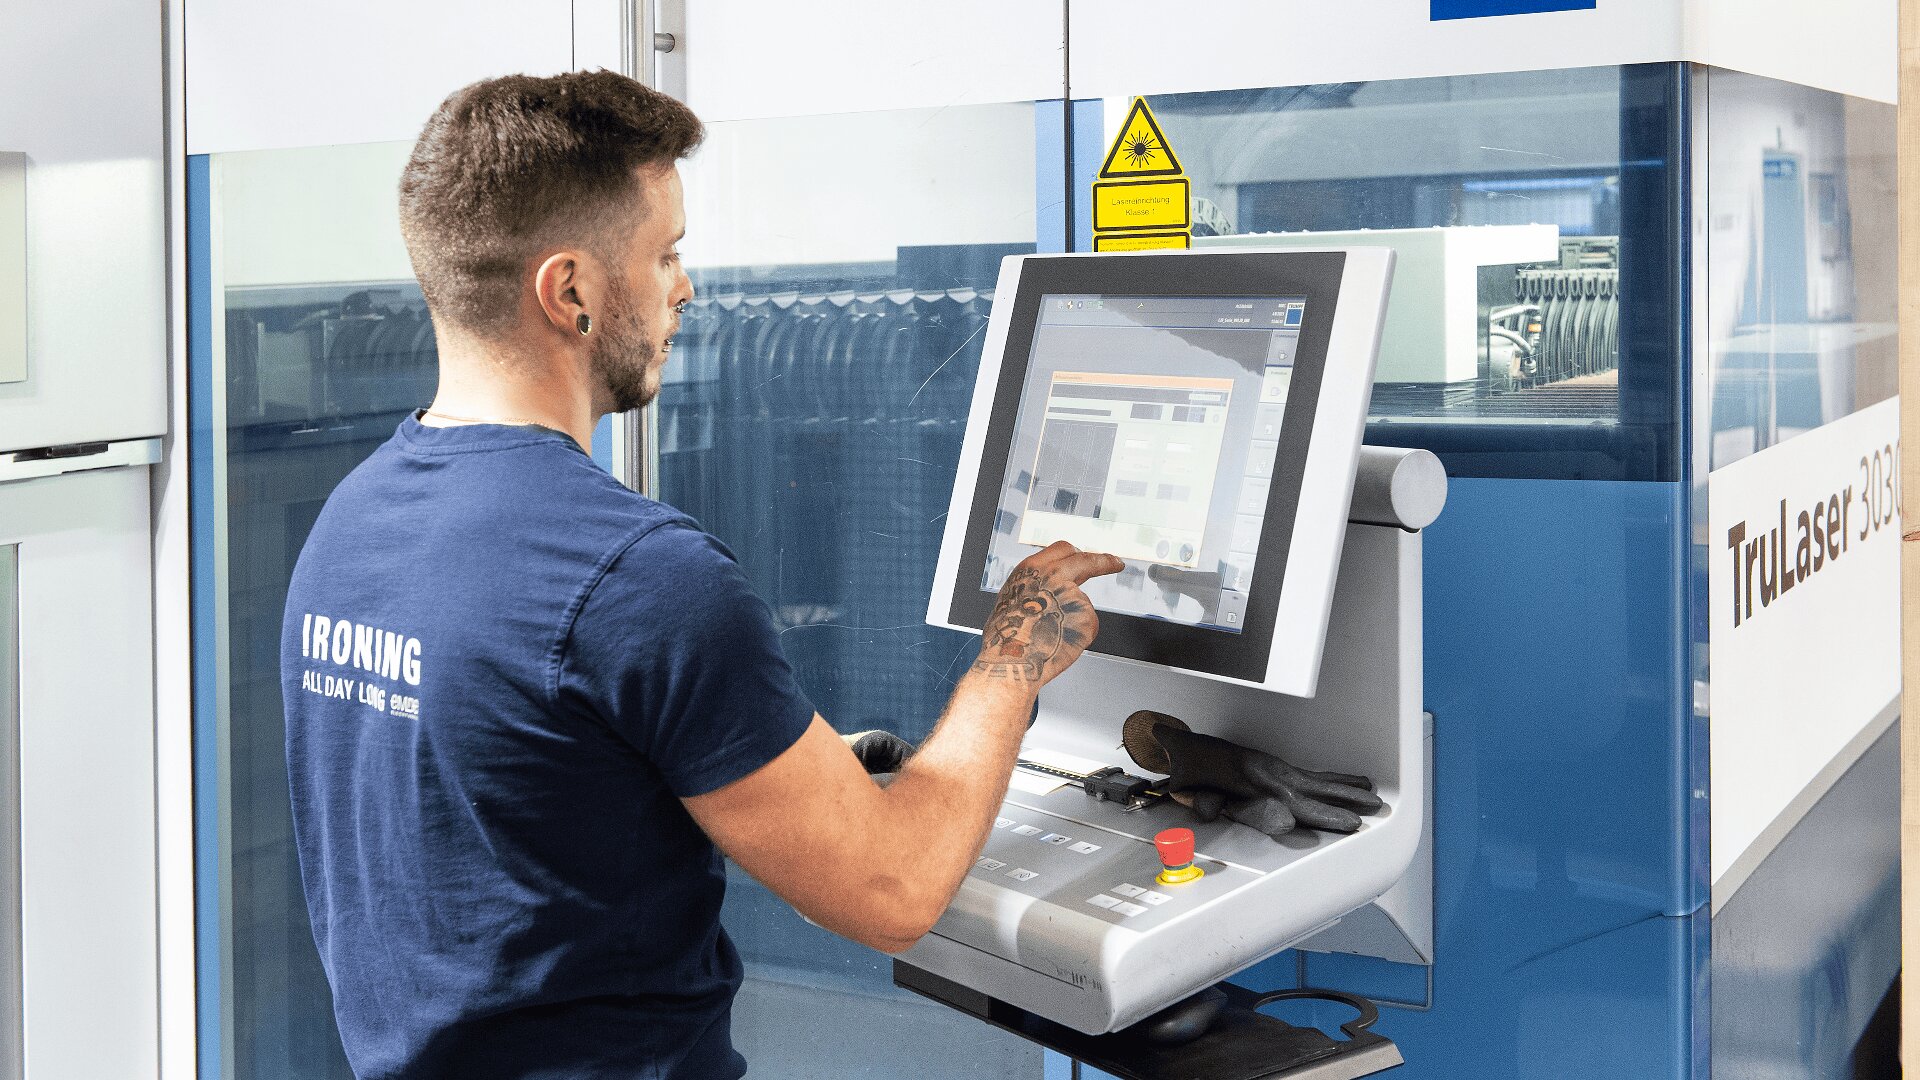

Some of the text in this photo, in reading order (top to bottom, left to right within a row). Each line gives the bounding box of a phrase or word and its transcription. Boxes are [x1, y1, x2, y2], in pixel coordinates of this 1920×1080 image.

[1111, 197, 1170, 206] Lasereinrichtung
[1727, 484, 1852, 629] TruLaser
[302, 613, 421, 686] IRONING
[302, 669, 386, 712] ALL DAY LONG
